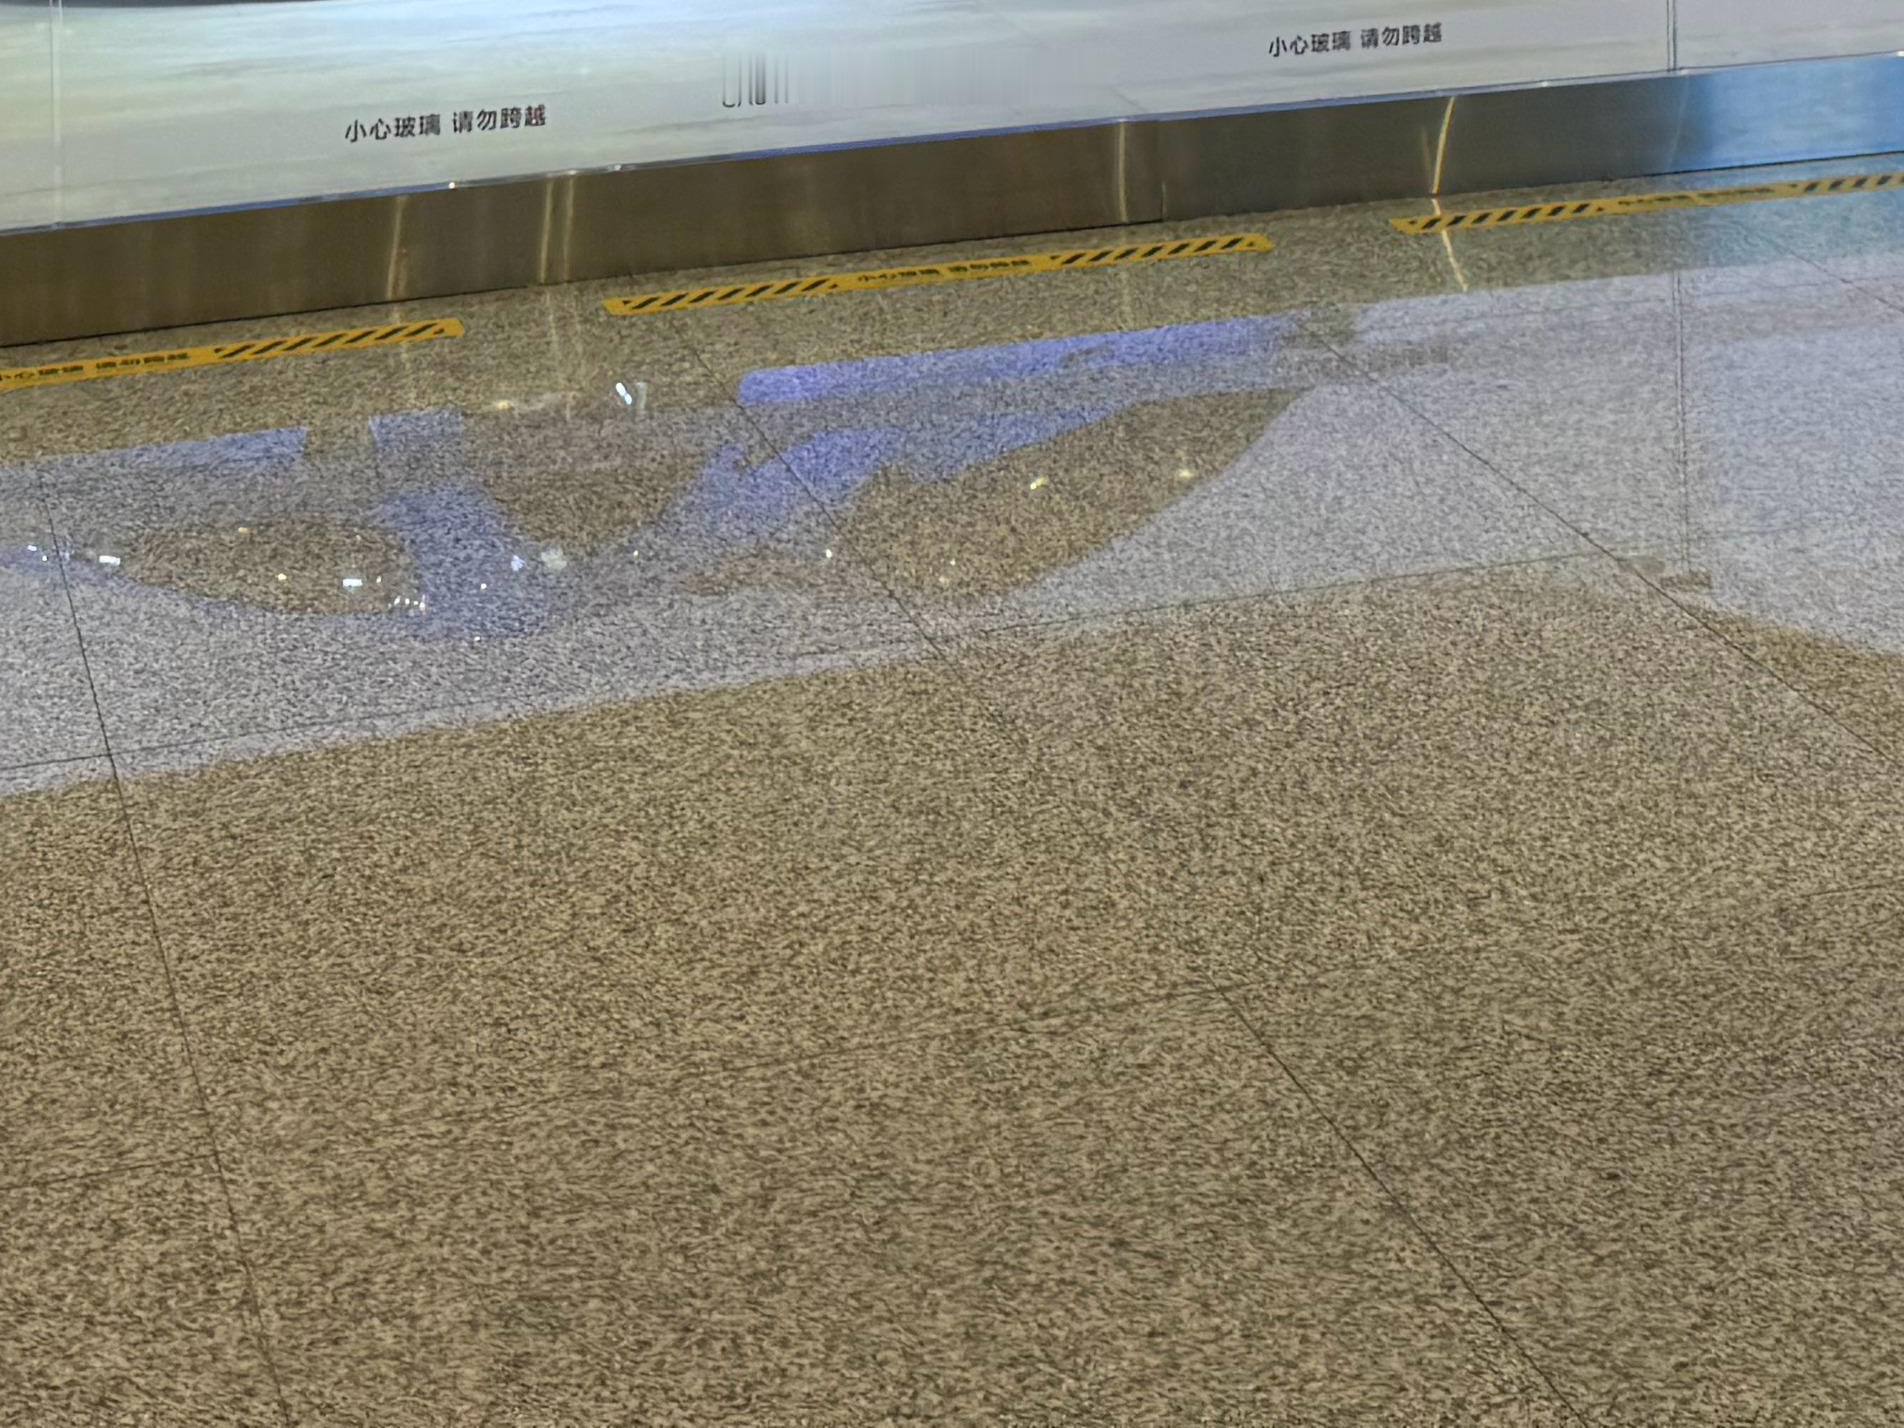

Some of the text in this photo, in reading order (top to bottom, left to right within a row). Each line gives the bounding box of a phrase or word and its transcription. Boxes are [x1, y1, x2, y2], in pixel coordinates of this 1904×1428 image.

[1269, 22, 1442, 57] 小心玻璃 请勿跨越
[345, 104, 546, 143] 小心玻璃 请勿跨越
